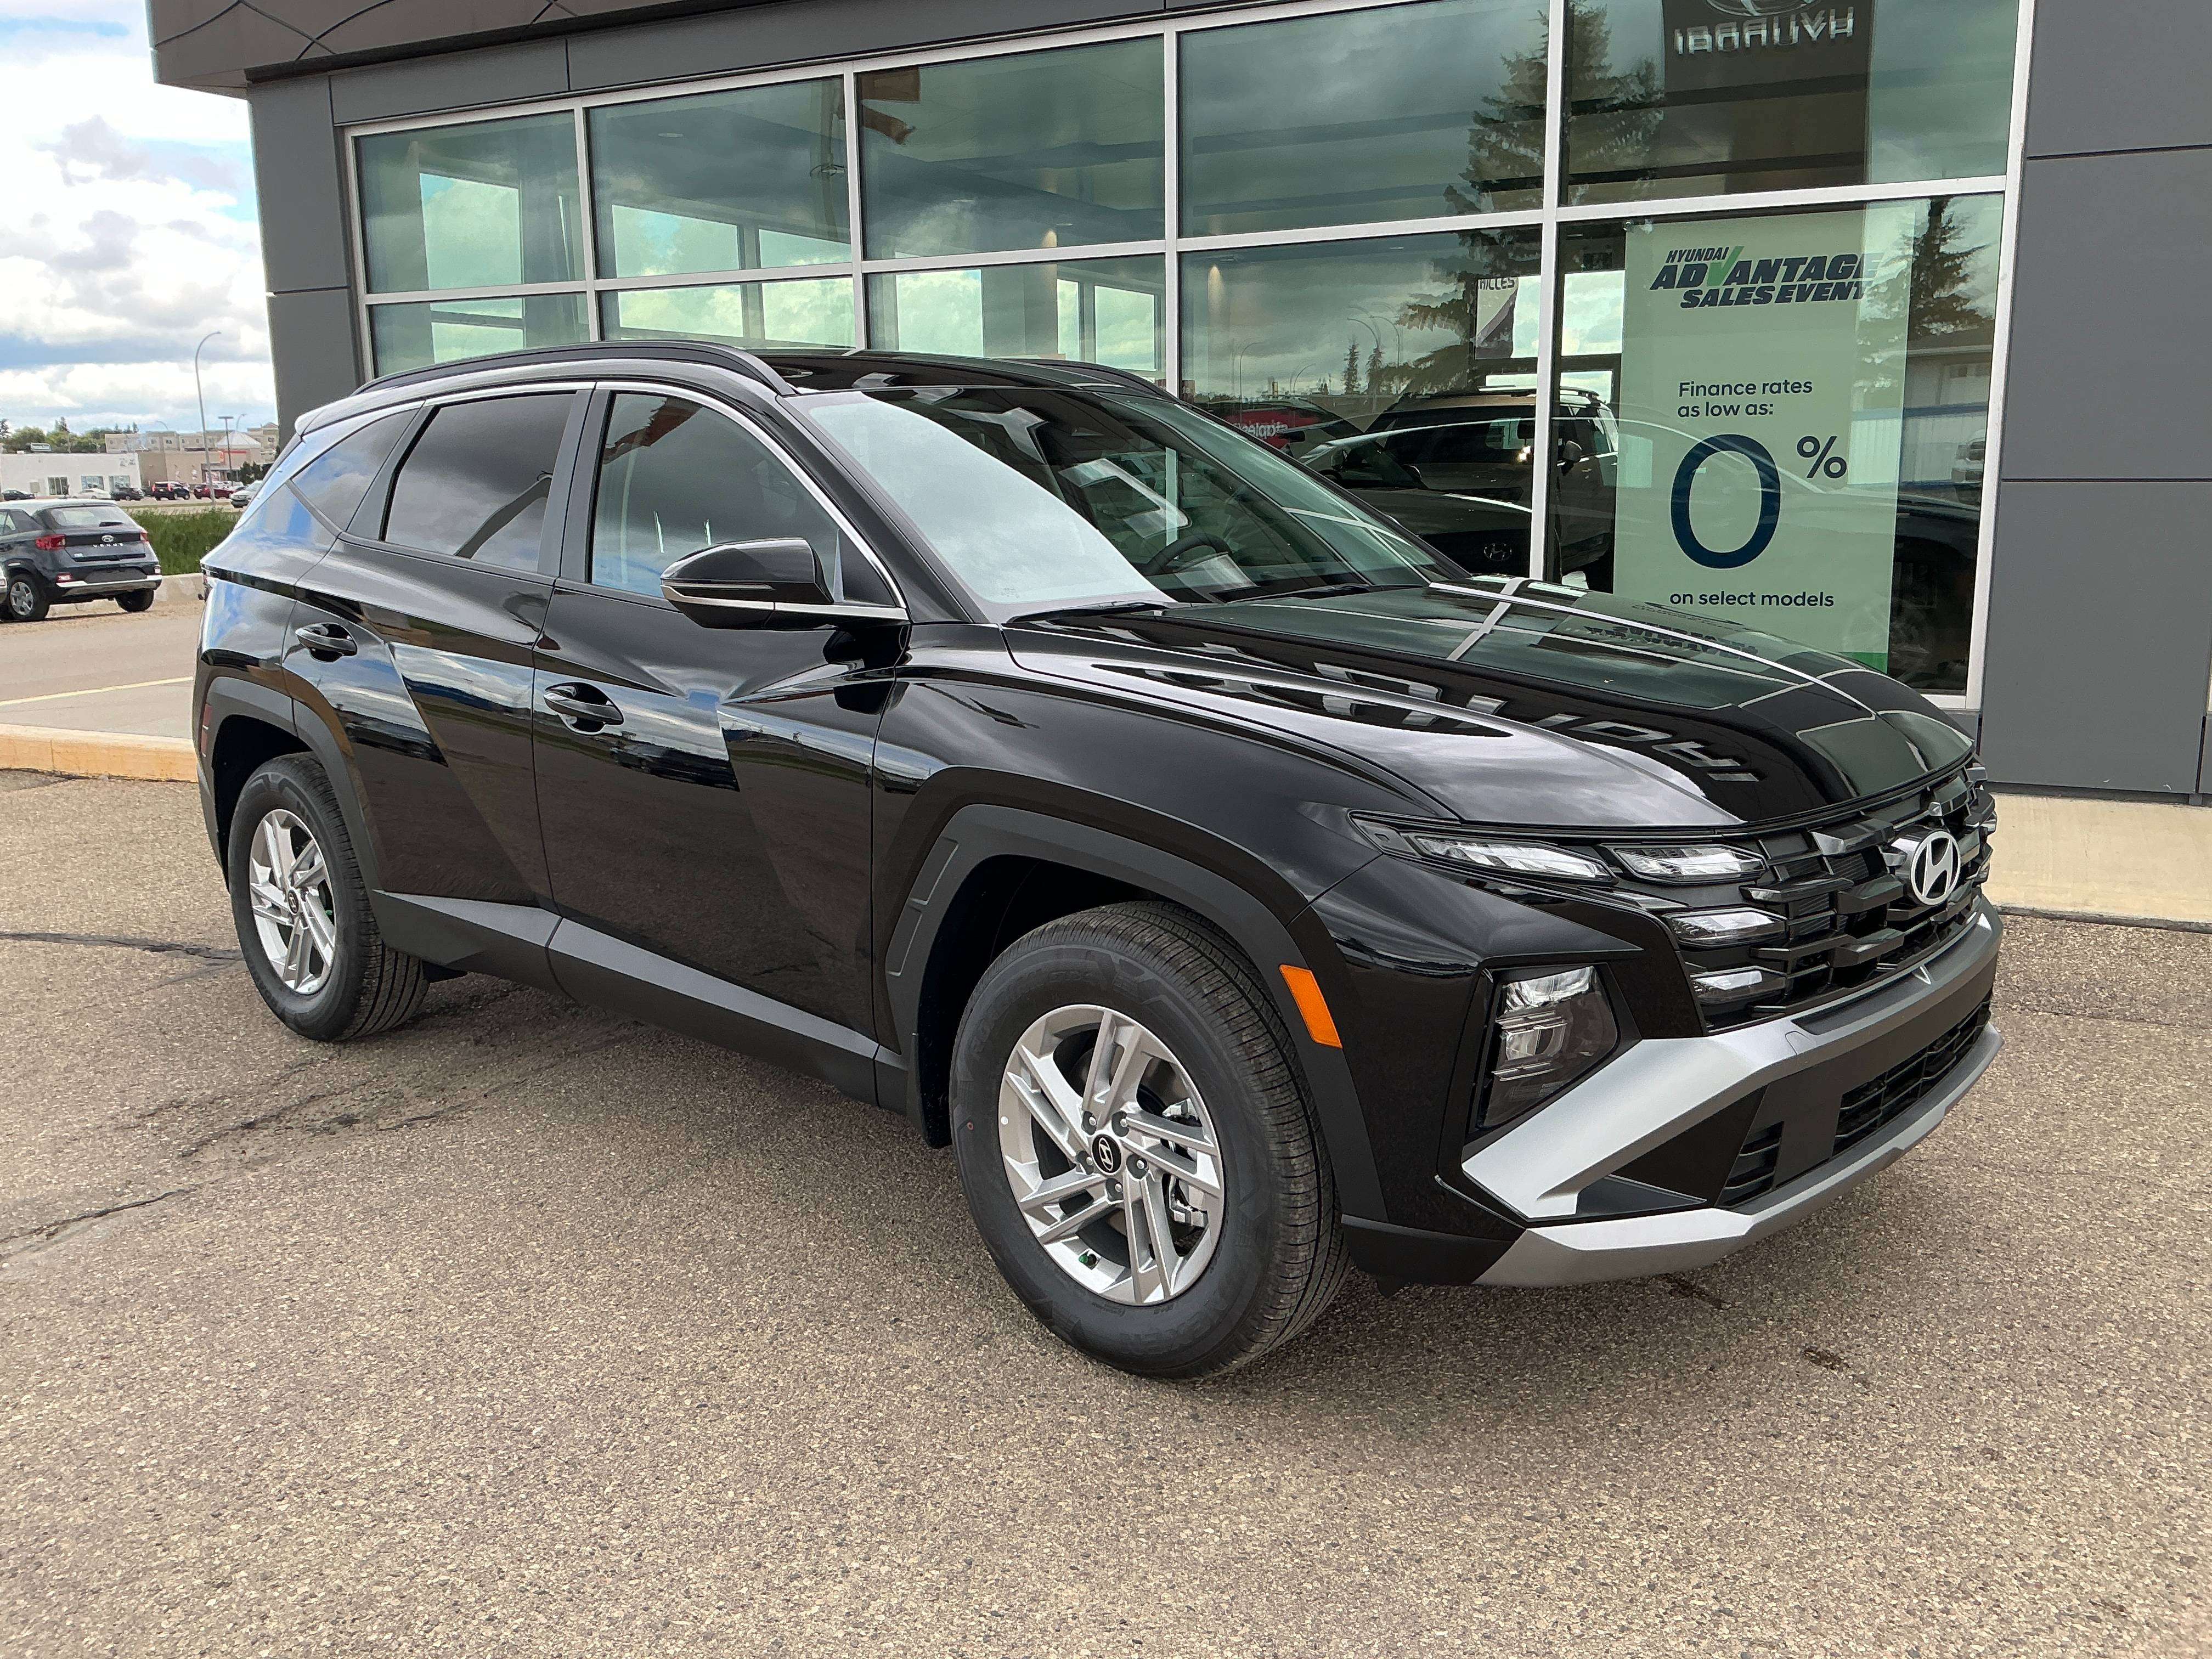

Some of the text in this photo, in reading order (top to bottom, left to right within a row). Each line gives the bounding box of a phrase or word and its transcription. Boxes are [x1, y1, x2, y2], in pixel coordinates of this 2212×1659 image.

[1665, 246, 1729, 263] HYUNDAI
[1680, 280, 1874, 308] SALES EVENT
[1679, 380, 1813, 397] Finance rates
[1678, 402, 1774, 417] as low as:
[1669, 590, 1834, 607] on select models
